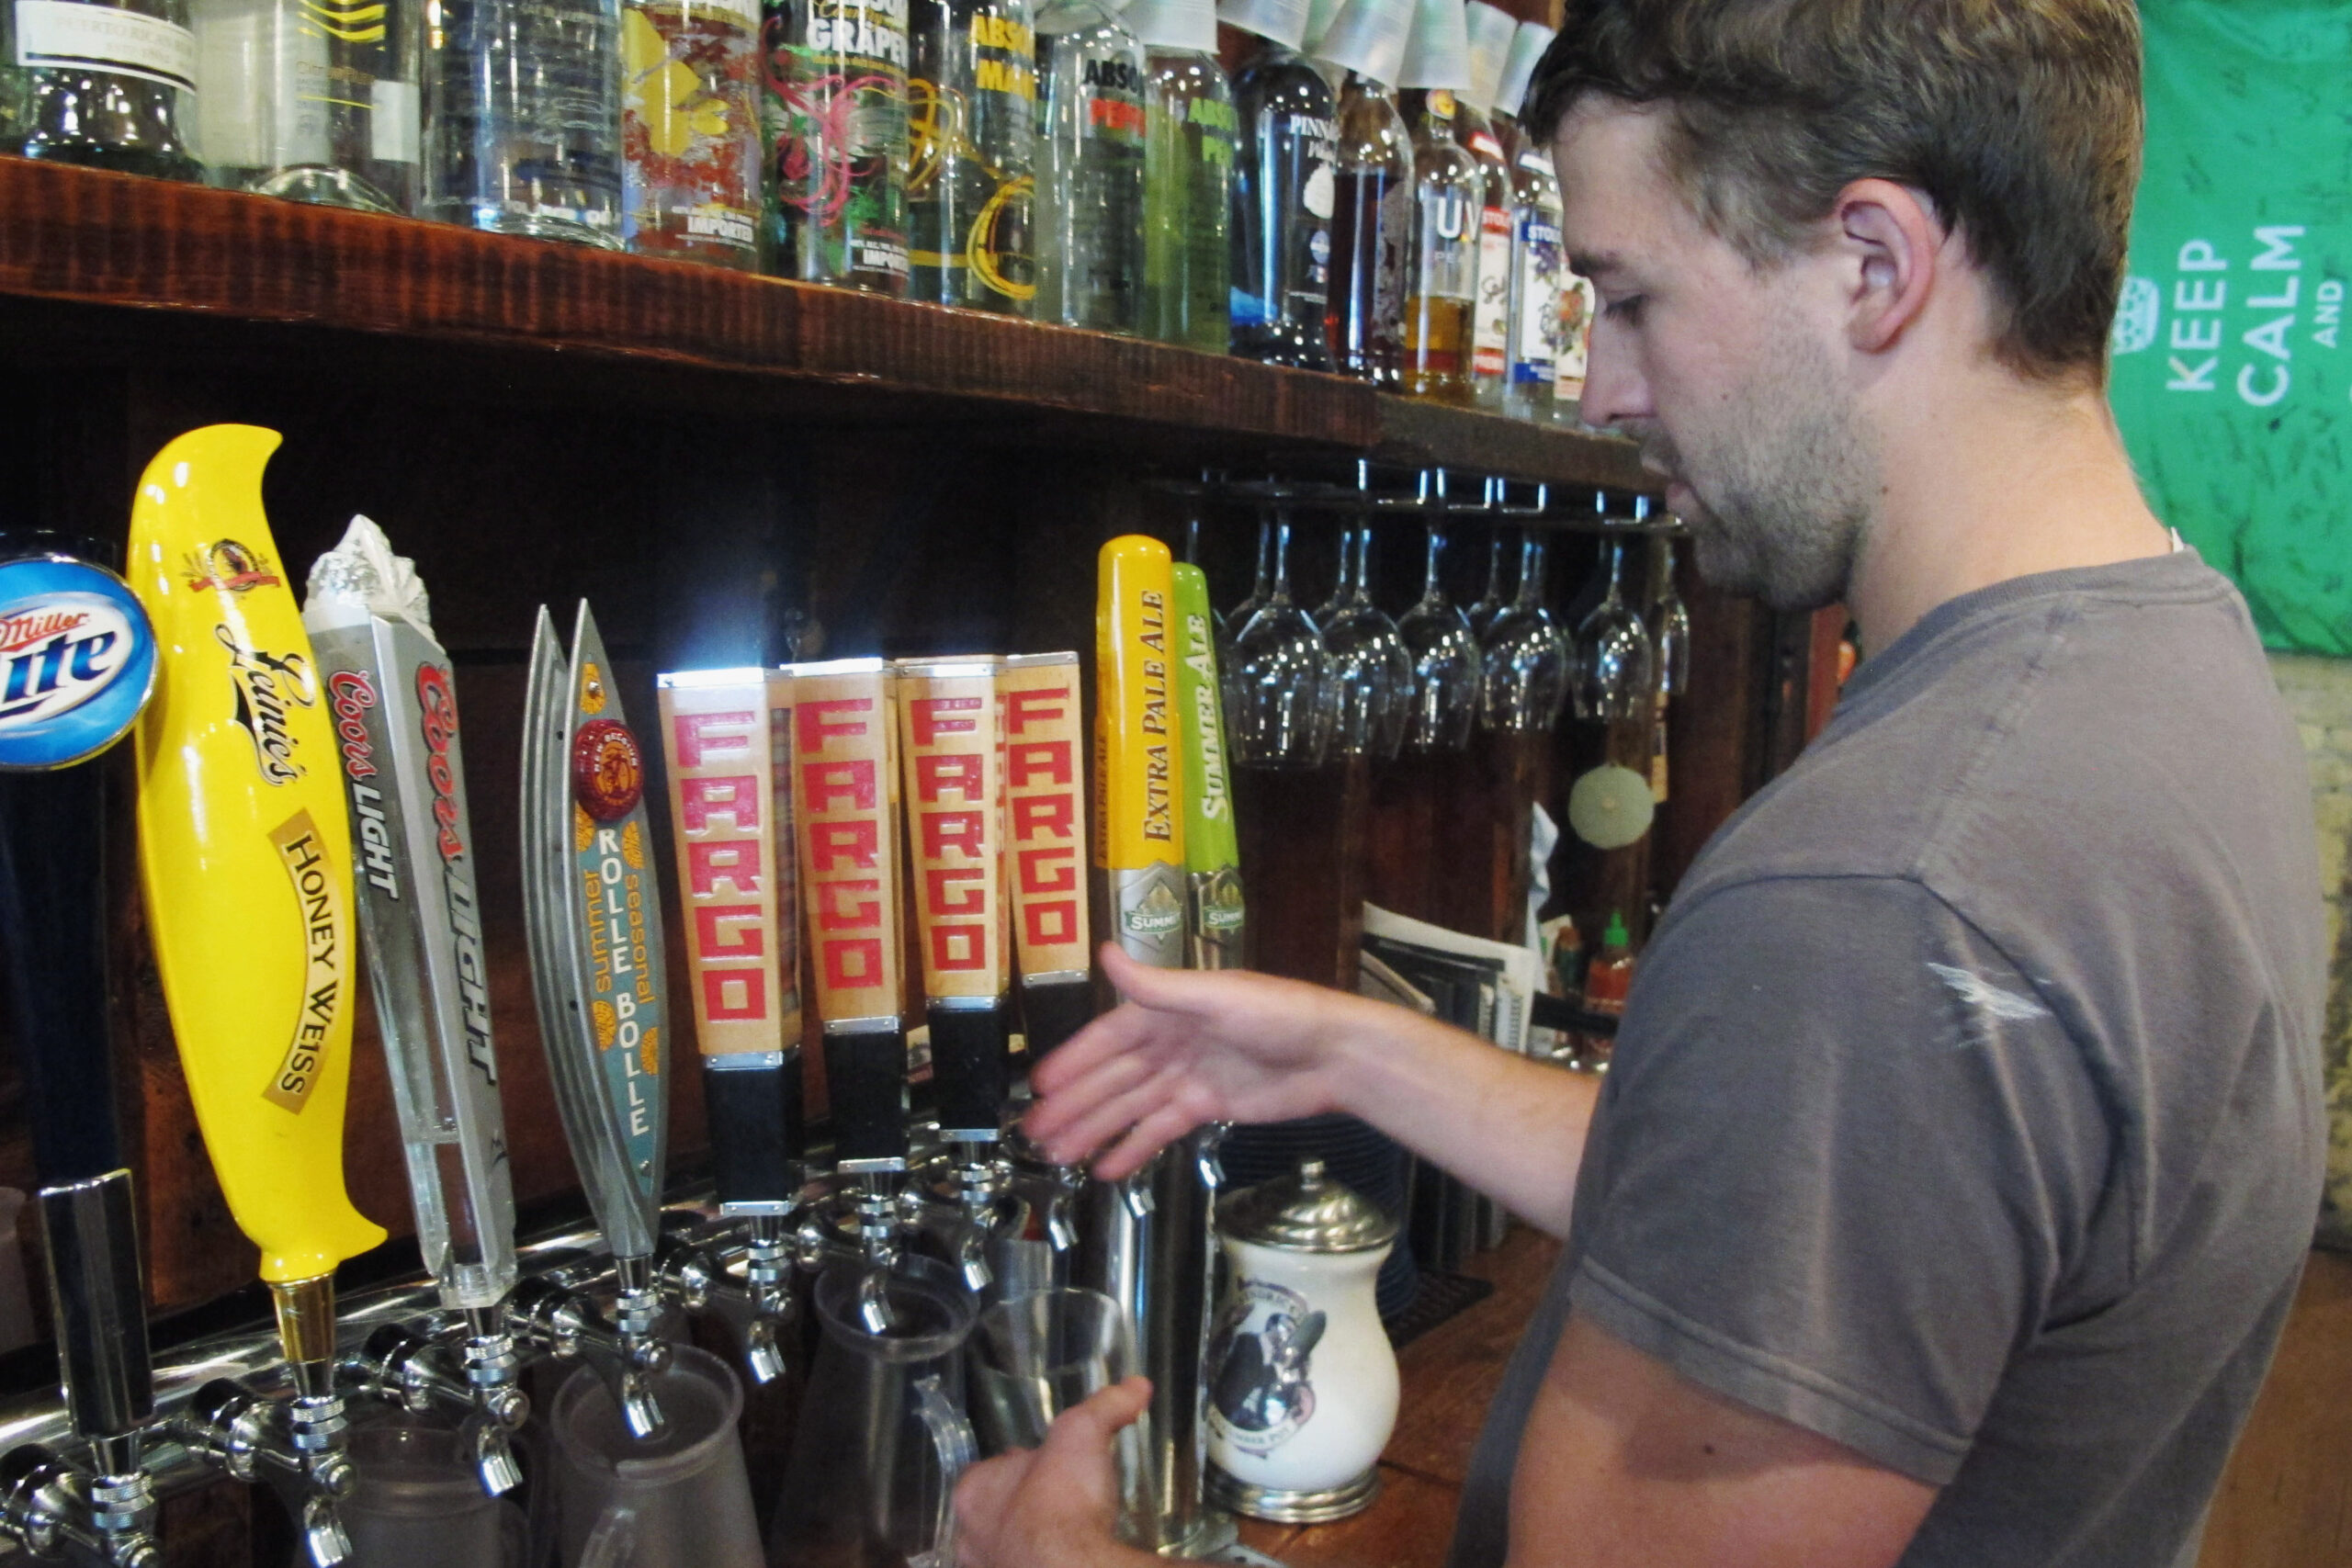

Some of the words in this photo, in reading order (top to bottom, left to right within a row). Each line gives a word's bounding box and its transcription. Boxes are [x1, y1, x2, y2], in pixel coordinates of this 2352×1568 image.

[1437, 196, 1483, 240] UV
[2165, 239, 2228, 391] KEEP
[2236, 224, 2306, 407] CALM
[2312, 280, 2343, 349] AND
[0, 613, 90, 645] Miller
[1139, 589, 1164, 655] ALE
[1185, 614, 1213, 682] ALE
[329, 670, 378, 781] Coors
[1142, 658, 1167, 737] PALE
[1196, 683, 1228, 822] SUMMER
[353, 782, 400, 900] LIGHT
[795, 697, 883, 990] FARGO
[910, 696, 986, 971] FARGO
[1008, 687, 1079, 946] FARGO
[1143, 744, 1171, 842] EXTRA
[286, 834, 335, 972] HONEY
[417, 661, 463, 863] Coors
[444, 865, 497, 1086] LIGHT
[673, 710, 767, 1021] FARGO
[583, 868, 612, 994] summer
[624, 874, 656, 1004] seasonal
[598, 829, 631, 974] ROLLE
[616, 992, 650, 1137] BOLLE
[280, 981, 338, 1095] WEISS
